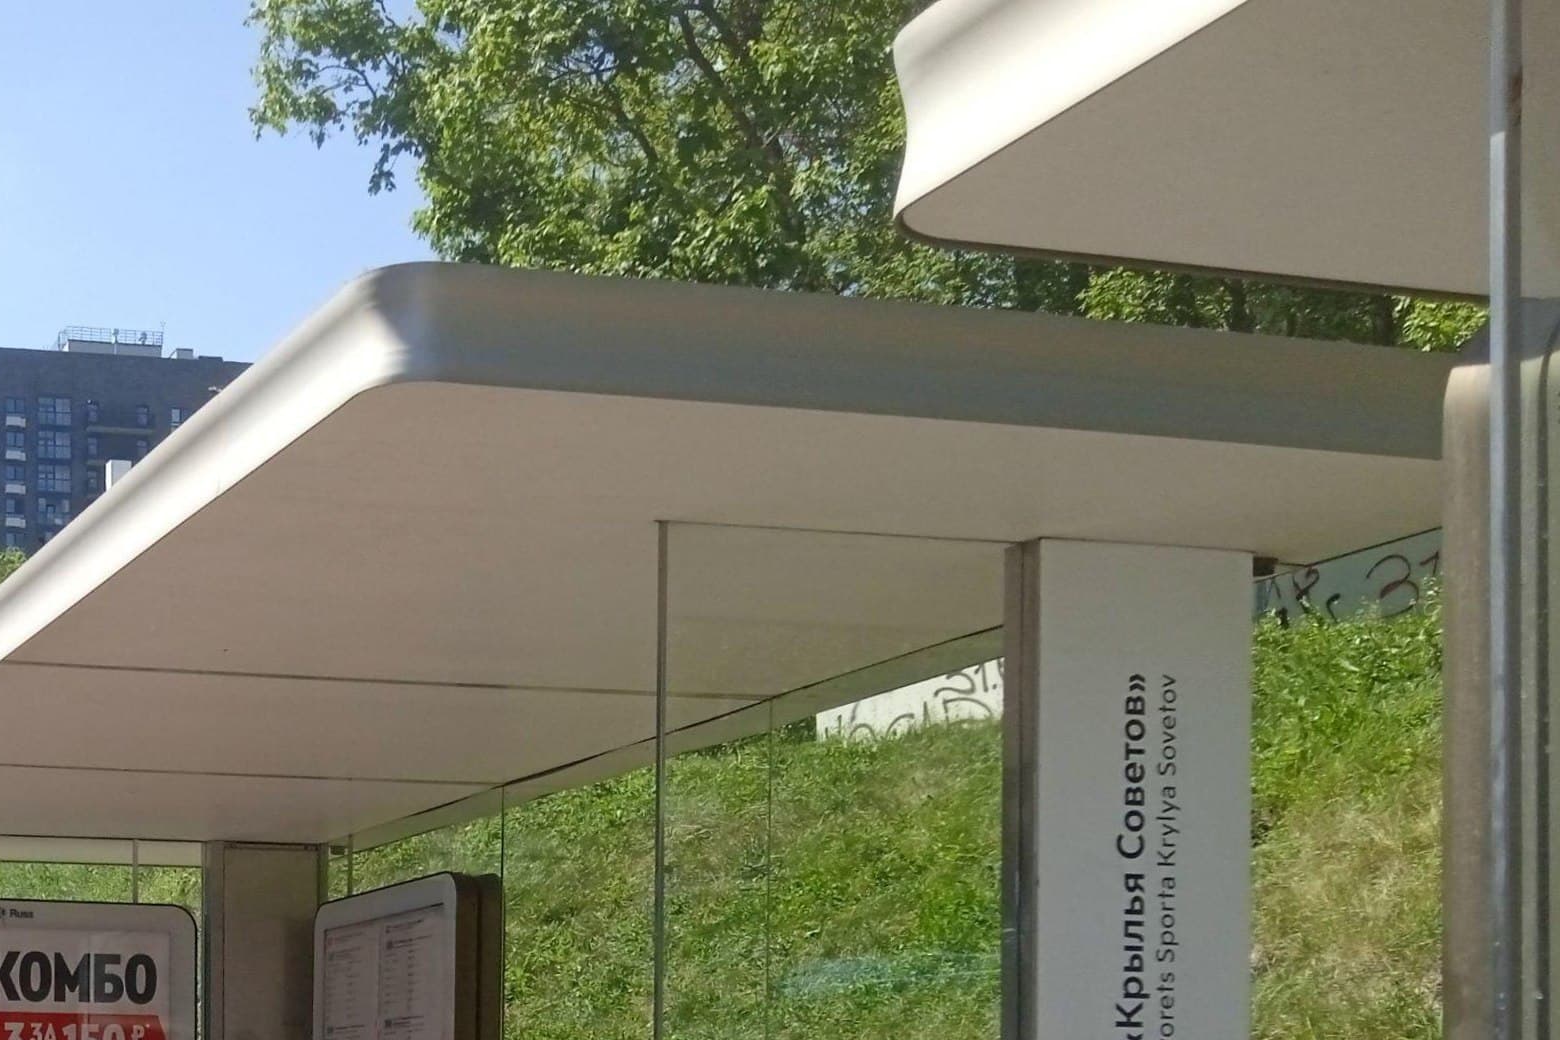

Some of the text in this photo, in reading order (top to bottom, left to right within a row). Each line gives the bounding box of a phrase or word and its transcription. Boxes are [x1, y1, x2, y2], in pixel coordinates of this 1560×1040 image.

[1115, 673, 1147, 860] Советов»
[1156, 674, 1178, 777] Sovetov
[1155, 785, 1182, 867] Krylya
[1155, 876, 1180, 963] Sporta
